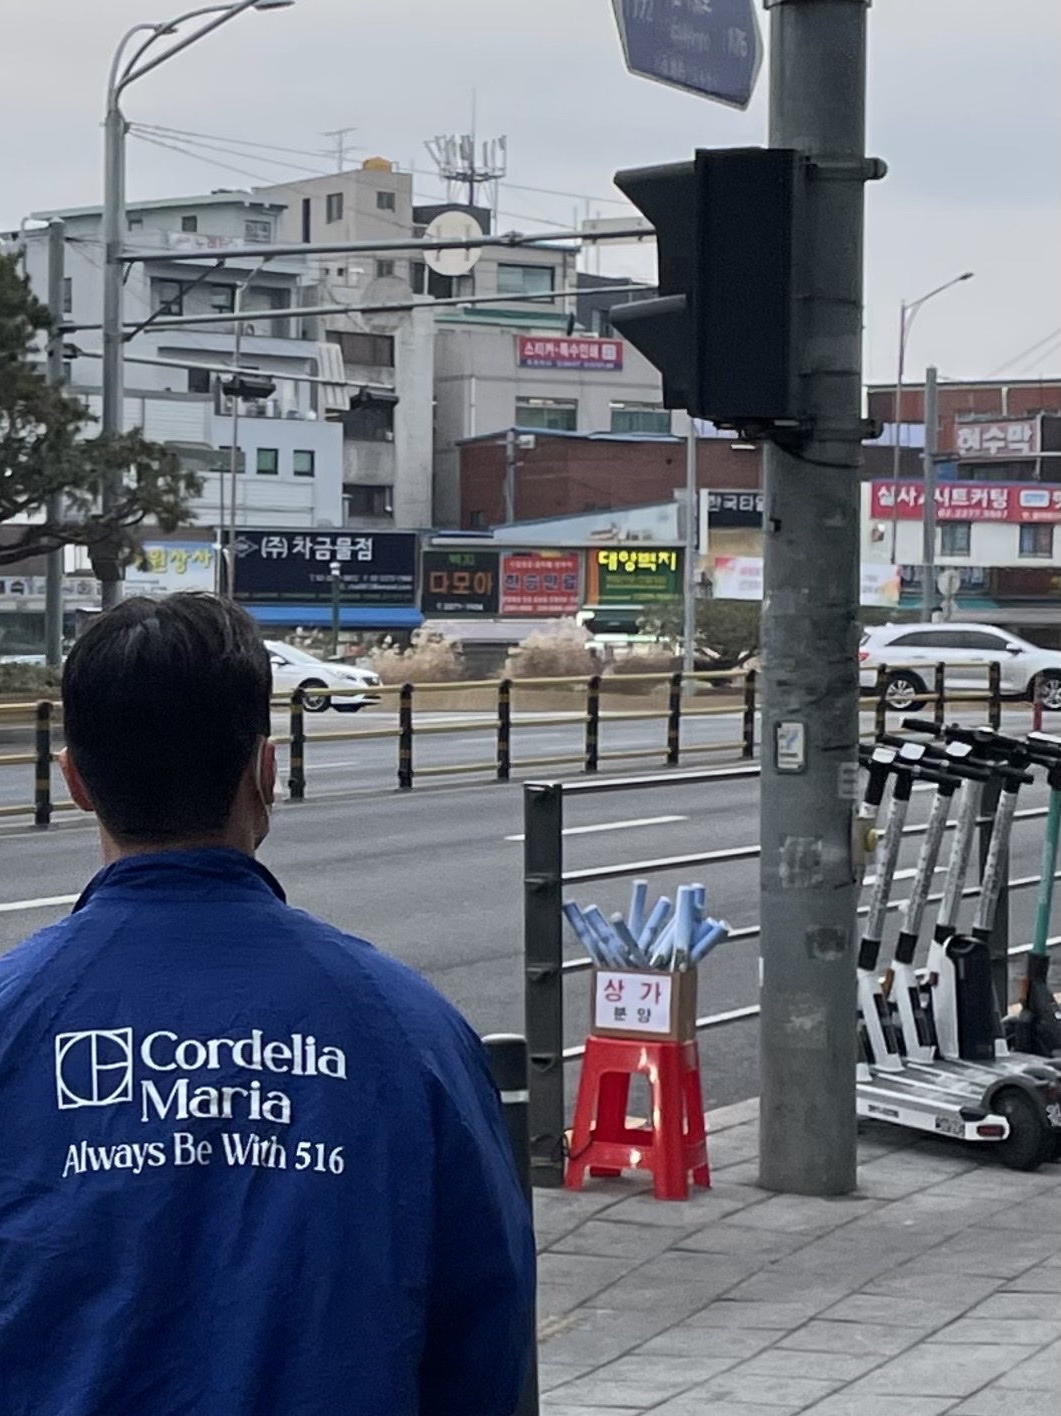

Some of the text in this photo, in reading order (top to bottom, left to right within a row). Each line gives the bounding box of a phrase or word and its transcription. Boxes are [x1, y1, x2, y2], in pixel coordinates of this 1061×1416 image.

[957, 424, 1033, 455] 현수막
[261, 536, 289, 559] (주)
[429, 571, 492, 594] 다모아
[141, 1029, 347, 1080] Cordelia
[141, 1078, 291, 1124] Maria
[62, 1132, 345, 1178] Always Be With 516
